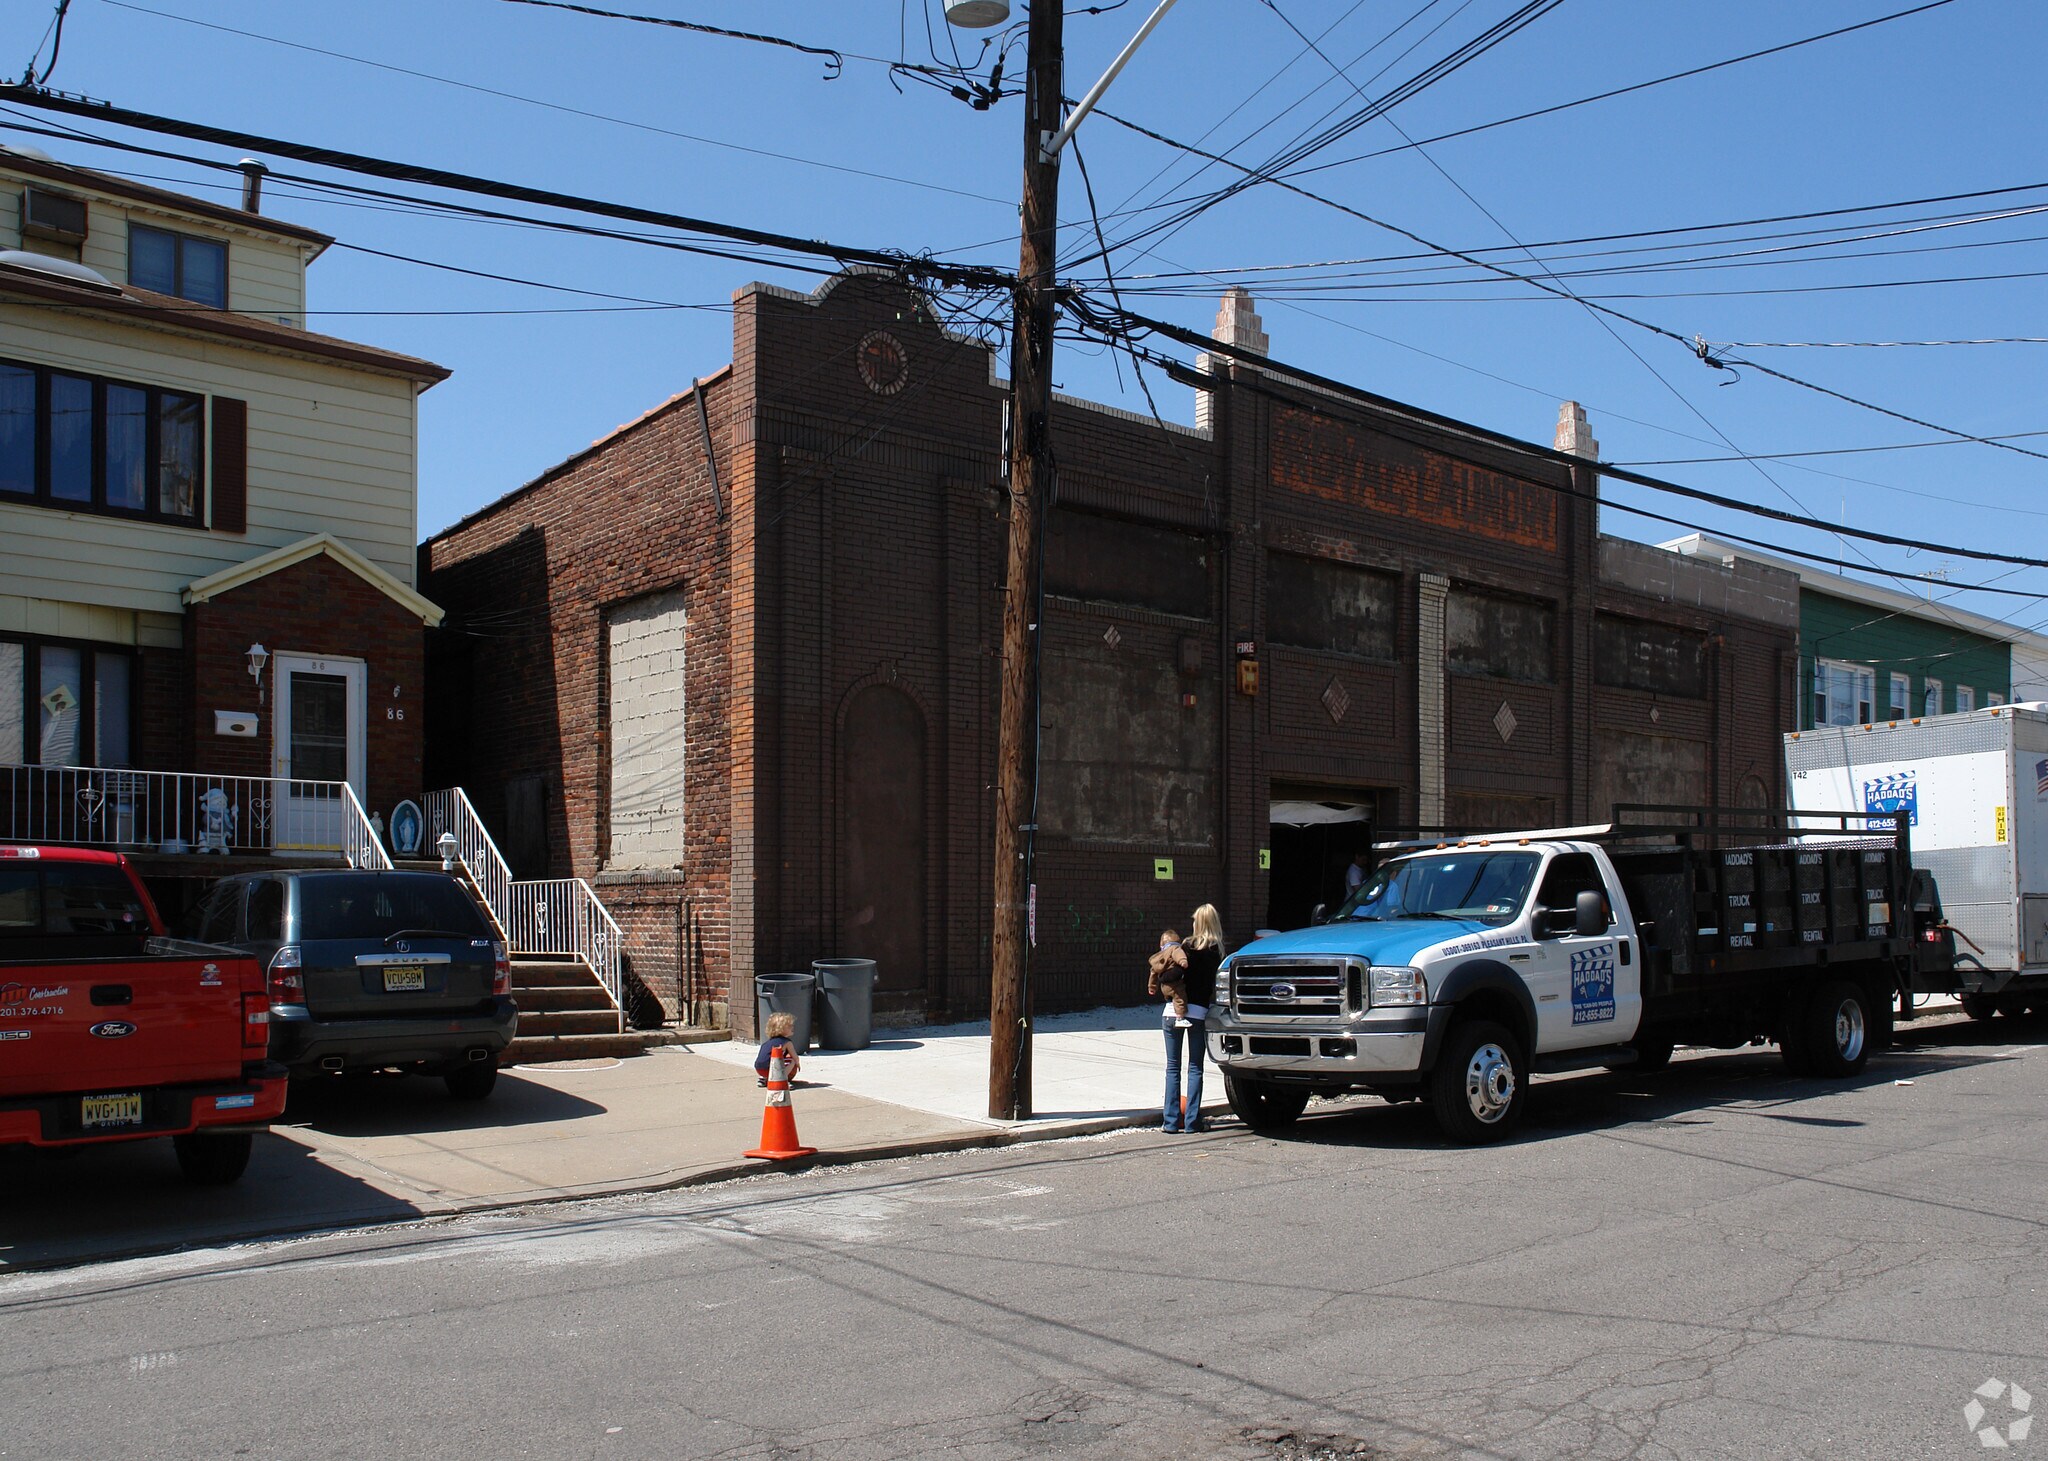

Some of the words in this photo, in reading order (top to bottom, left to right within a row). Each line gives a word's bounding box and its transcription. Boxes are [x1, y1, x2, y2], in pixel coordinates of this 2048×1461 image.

[1236, 642, 1254, 654] FIRE
[312, 661, 325, 671] 86
[387, 707, 404, 720] 86
[1793, 771, 1808, 780] T42
[1867, 788, 1913, 804] HADDAD'S
[1799, 853, 1823, 865] ADDAD'S
[1864, 852, 1886, 863] ADDAD'S
[1801, 893, 1821, 905] TRUCK
[1866, 889, 1884, 900] TRUCK
[1728, 895, 1750, 908] TRUCK
[1803, 931, 1824, 942] RENTAL
[1868, 926, 1887, 937] RENTAL
[1481, 938, 1505, 949] PLEASANT
[1730, 936, 1753, 948] RENTAL
[1574, 969, 1612, 988] HADDAD'S
[29, 987, 69, 1000] Construction
[0, 1006, 64, 1017] 201.376.4716
[101, 1024, 126, 1035] Ford
